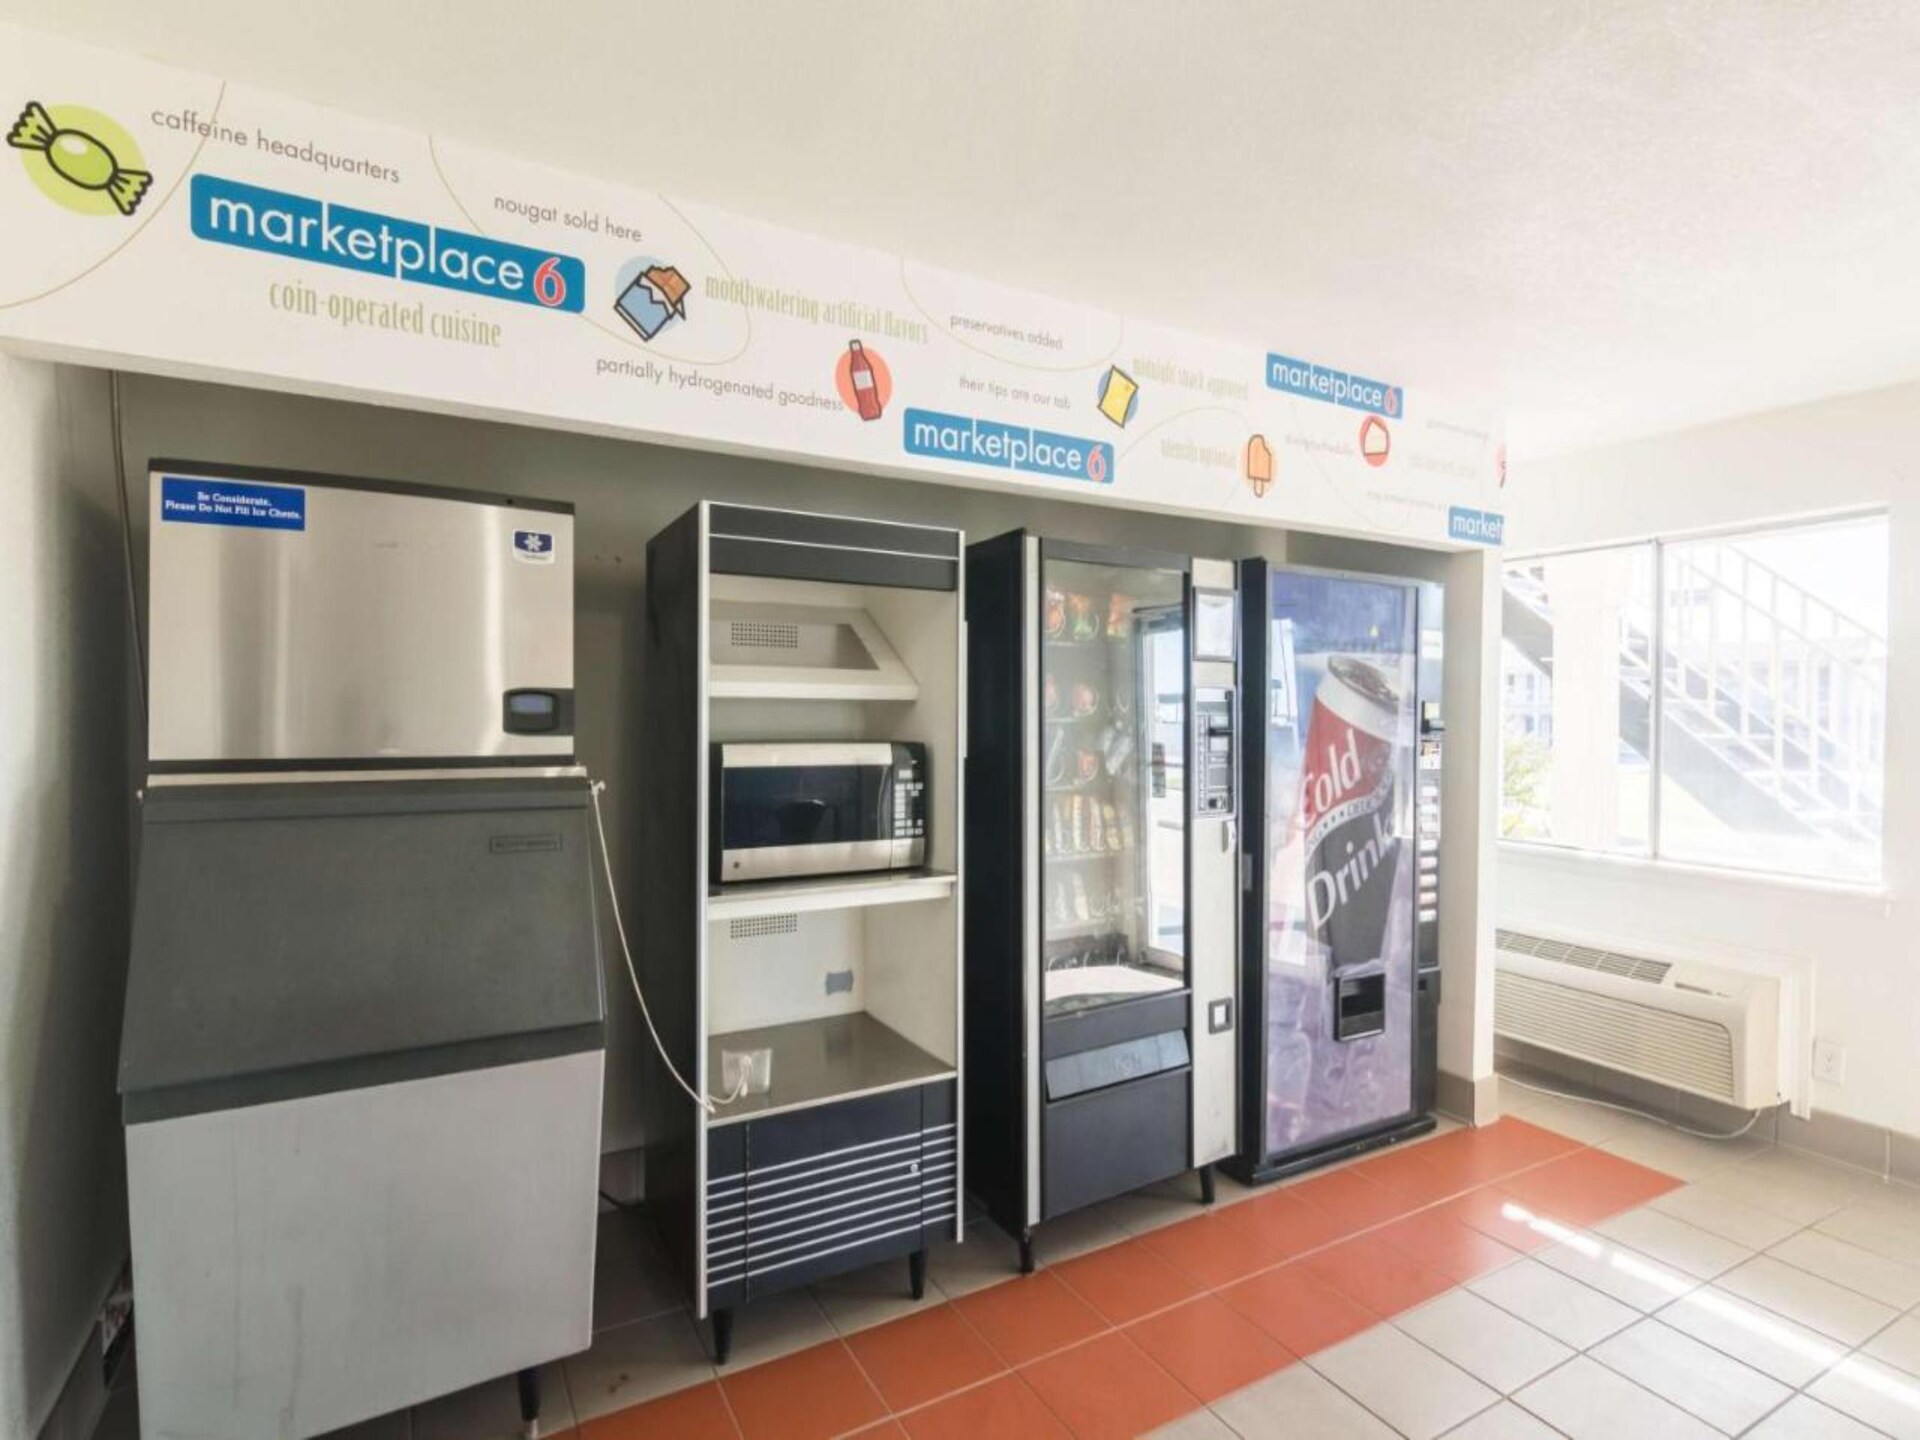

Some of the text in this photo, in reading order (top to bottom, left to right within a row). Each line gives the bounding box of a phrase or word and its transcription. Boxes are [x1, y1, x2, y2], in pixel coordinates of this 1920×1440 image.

[151, 109, 400, 185] caffeine headquarters
[494, 196, 643, 242] nougat sold here
[209, 194, 567, 307] marketplace 6
[269, 279, 502, 347] coin-operated cuisine
[705, 276, 929, 345] mouthwatering artificial flavors
[950, 314, 1063, 350] preservatives added
[597, 356, 844, 412] partially hydrogenated goodness
[959, 376, 985, 393] their
[1011, 388, 1030, 402] are
[1033, 392, 1050, 406] our
[1272, 362, 1382, 406] marketplace
[914, 418, 1082, 470] marketplace
[1087, 442, 1107, 482] 6
[165, 499, 196, 511] Please
[198, 502, 213, 513] Do
[215, 504, 232, 514] Not
[1306, 812, 1397, 930] Drink
